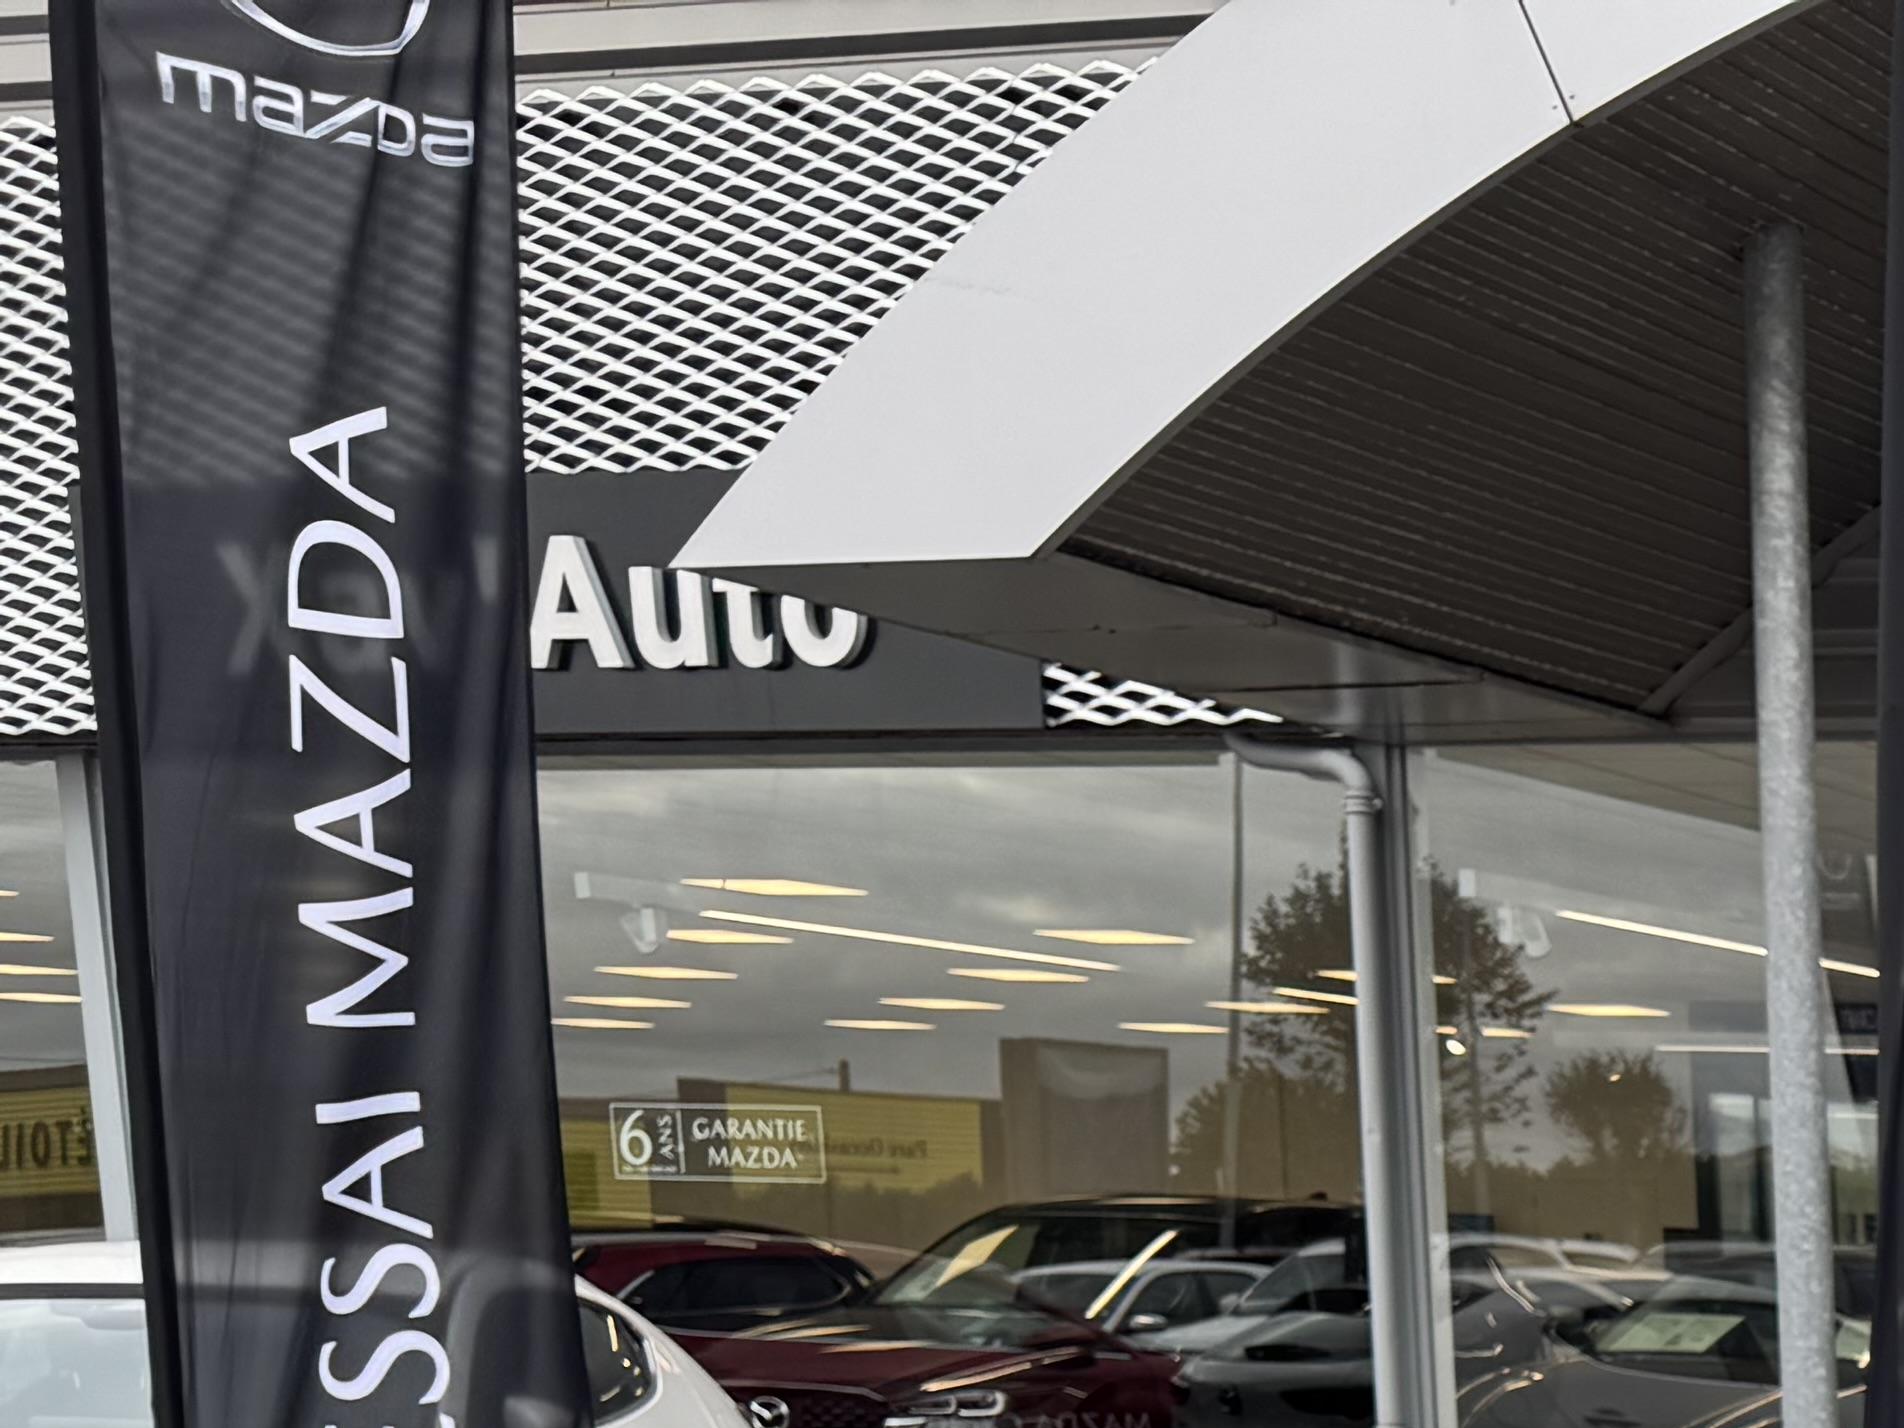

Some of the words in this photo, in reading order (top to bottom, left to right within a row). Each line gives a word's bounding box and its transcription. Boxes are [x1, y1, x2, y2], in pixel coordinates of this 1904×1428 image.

[156, 50, 475, 167] mazda
[530, 534, 864, 669] Auto
[288, 405, 416, 1028] MAZDA
[619, 1109, 653, 1166] 6
[656, 1114, 676, 1161] ANS
[691, 1116, 809, 1143] GARANTIE
[707, 1145, 800, 1170] MAZDA
